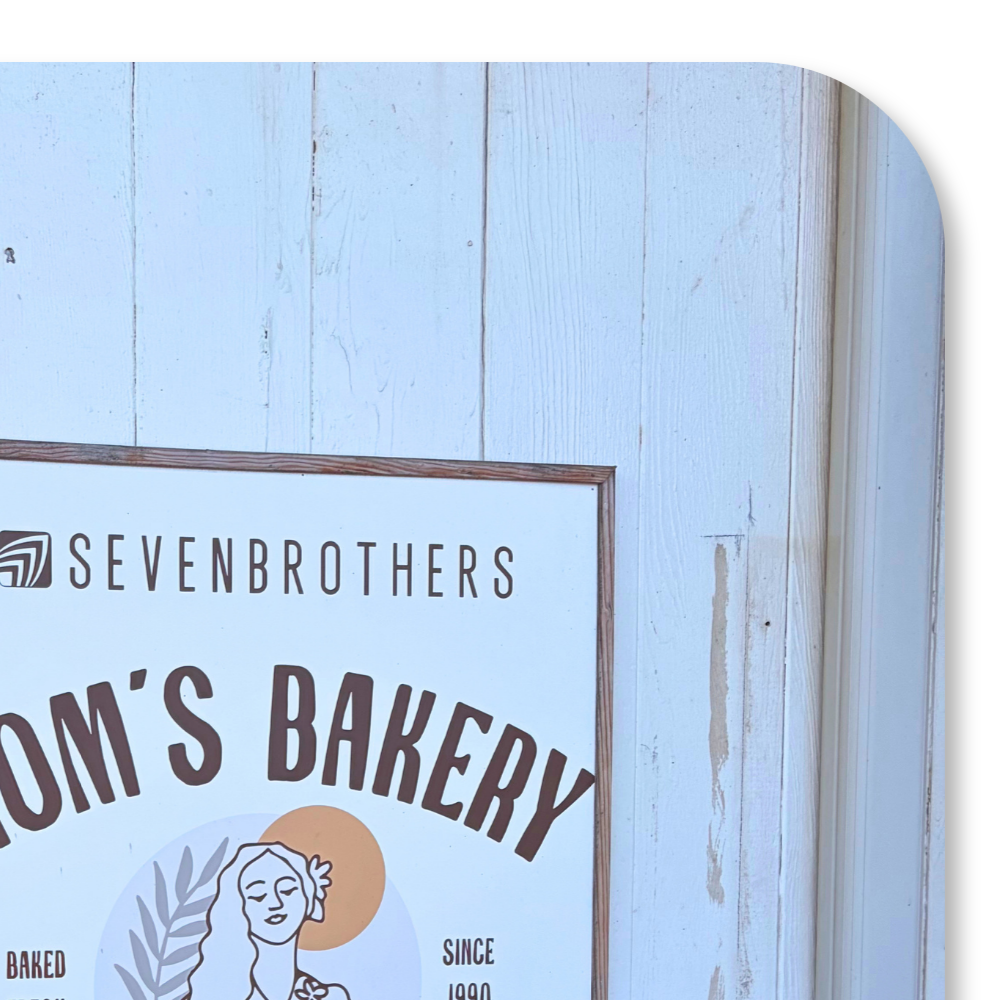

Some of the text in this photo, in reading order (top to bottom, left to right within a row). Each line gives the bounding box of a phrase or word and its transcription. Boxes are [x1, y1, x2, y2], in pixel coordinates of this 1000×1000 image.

[68, 531, 515, 600] SEVENBROTHERS
[267, 664, 597, 863] BAKERY
[6, 949, 66, 980] BAKED
[442, 937, 495, 966] SINCE
